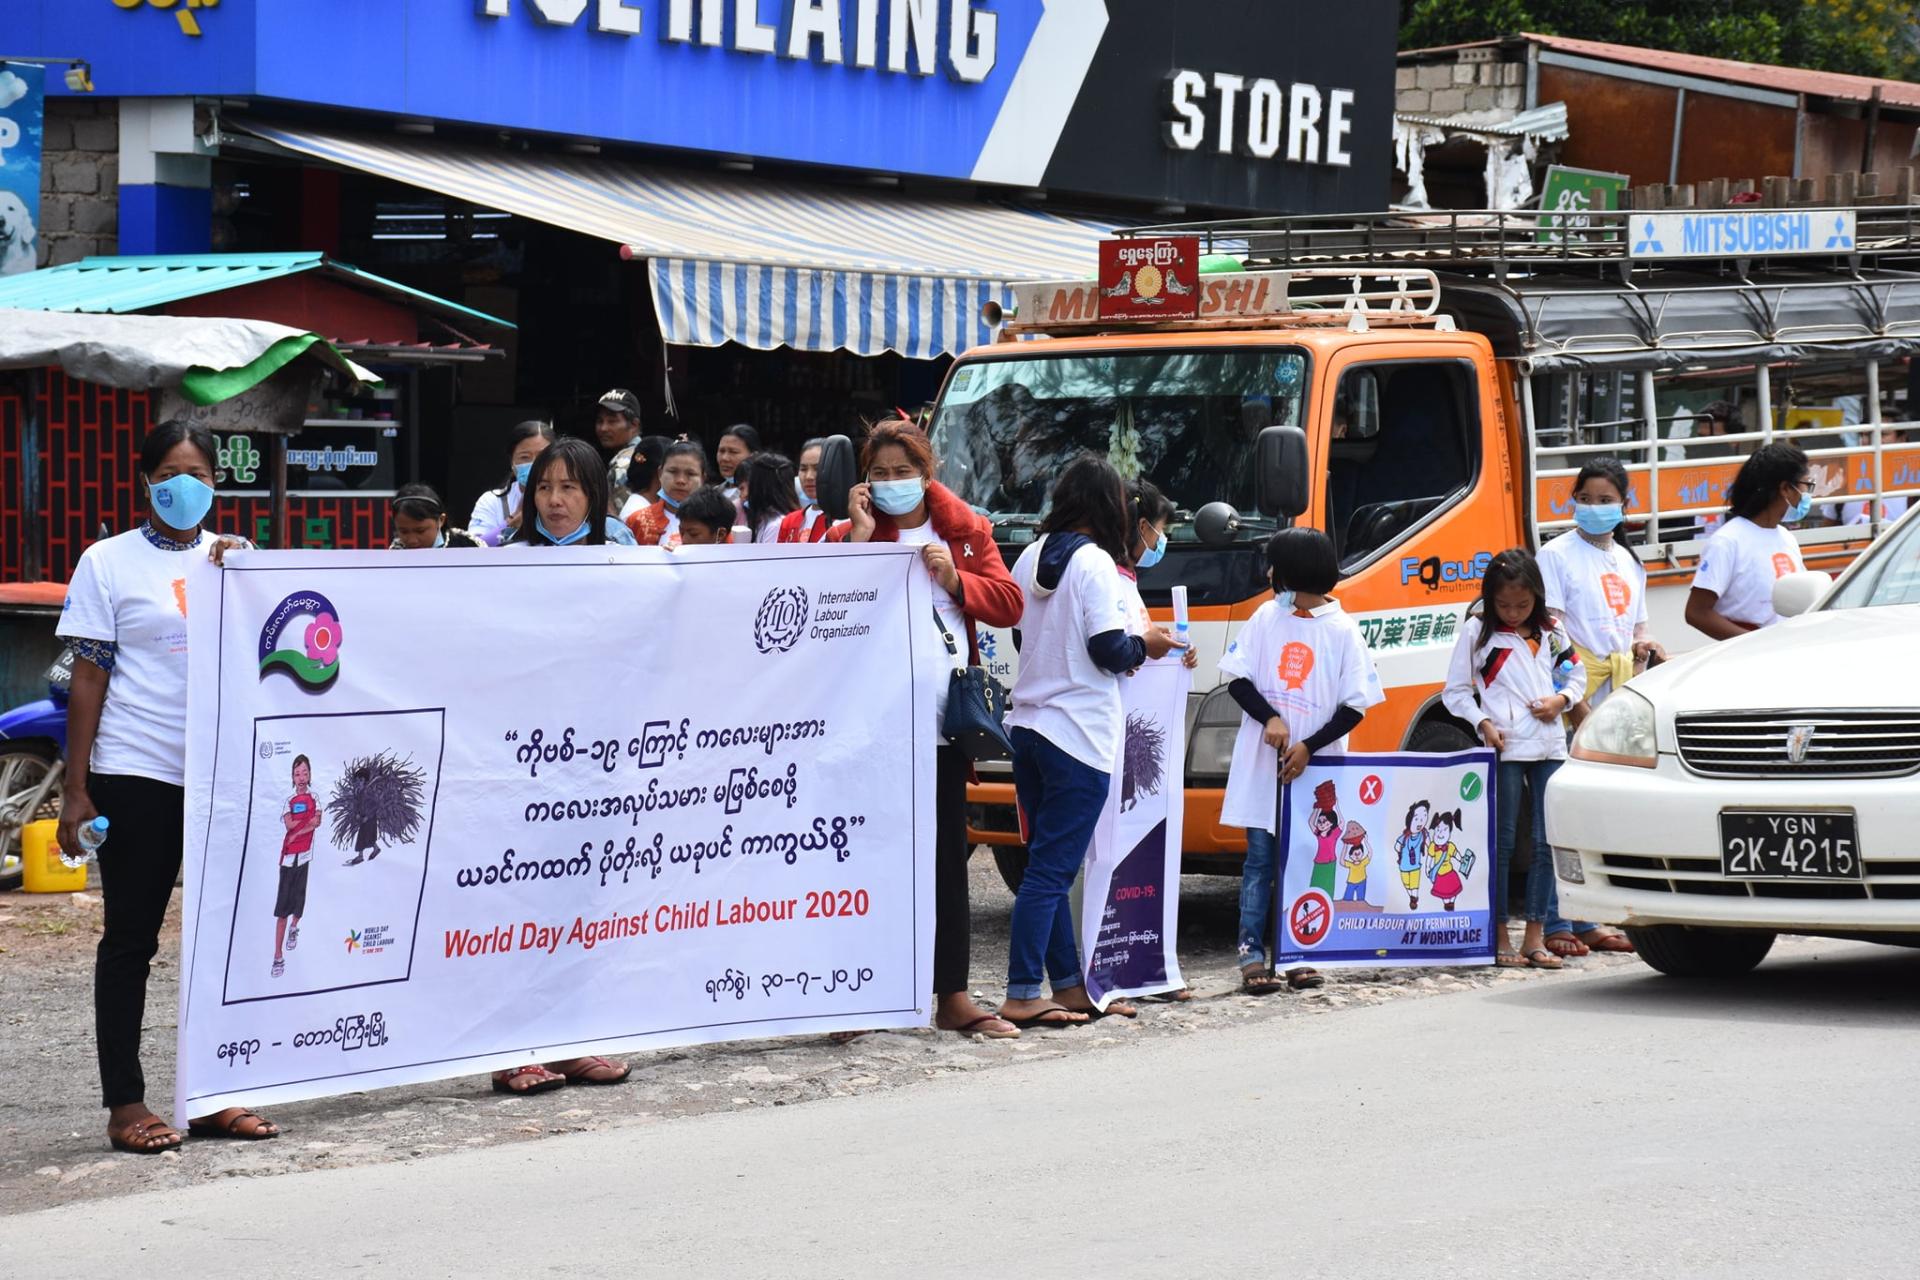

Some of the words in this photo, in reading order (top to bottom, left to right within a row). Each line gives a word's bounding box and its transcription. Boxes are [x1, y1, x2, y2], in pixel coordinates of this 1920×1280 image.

[1171, 70, 1354, 167] STORE
[1683, 214, 1811, 253] MITSUBISHI
[818, 588, 878, 605] International
[1440, 582, 1481, 593] multime
[769, 600, 795, 632] ILO
[814, 609, 849, 622] Labour
[810, 623, 870, 642] Organization
[986, 661, 1010, 675] tiet
[1768, 817, 1817, 835] YGN
[1728, 837, 1852, 874] 2K-4215
[444, 925, 512, 959] World
[519, 921, 564, 955] Day
[566, 909, 648, 951] Against
[654, 899, 709, 933] Child
[715, 895, 797, 927] Labour
[805, 888, 869, 919] 2020
[1338, 917, 1366, 930] CHILD
[1366, 917, 1405, 930] LABOUR
[1407, 917, 1425, 930] NOT
[1425, 916, 1471, 930] PERMITTED
[1401, 931, 1416, 945] AT
[1419, 928, 1482, 945] WORKPLACE
